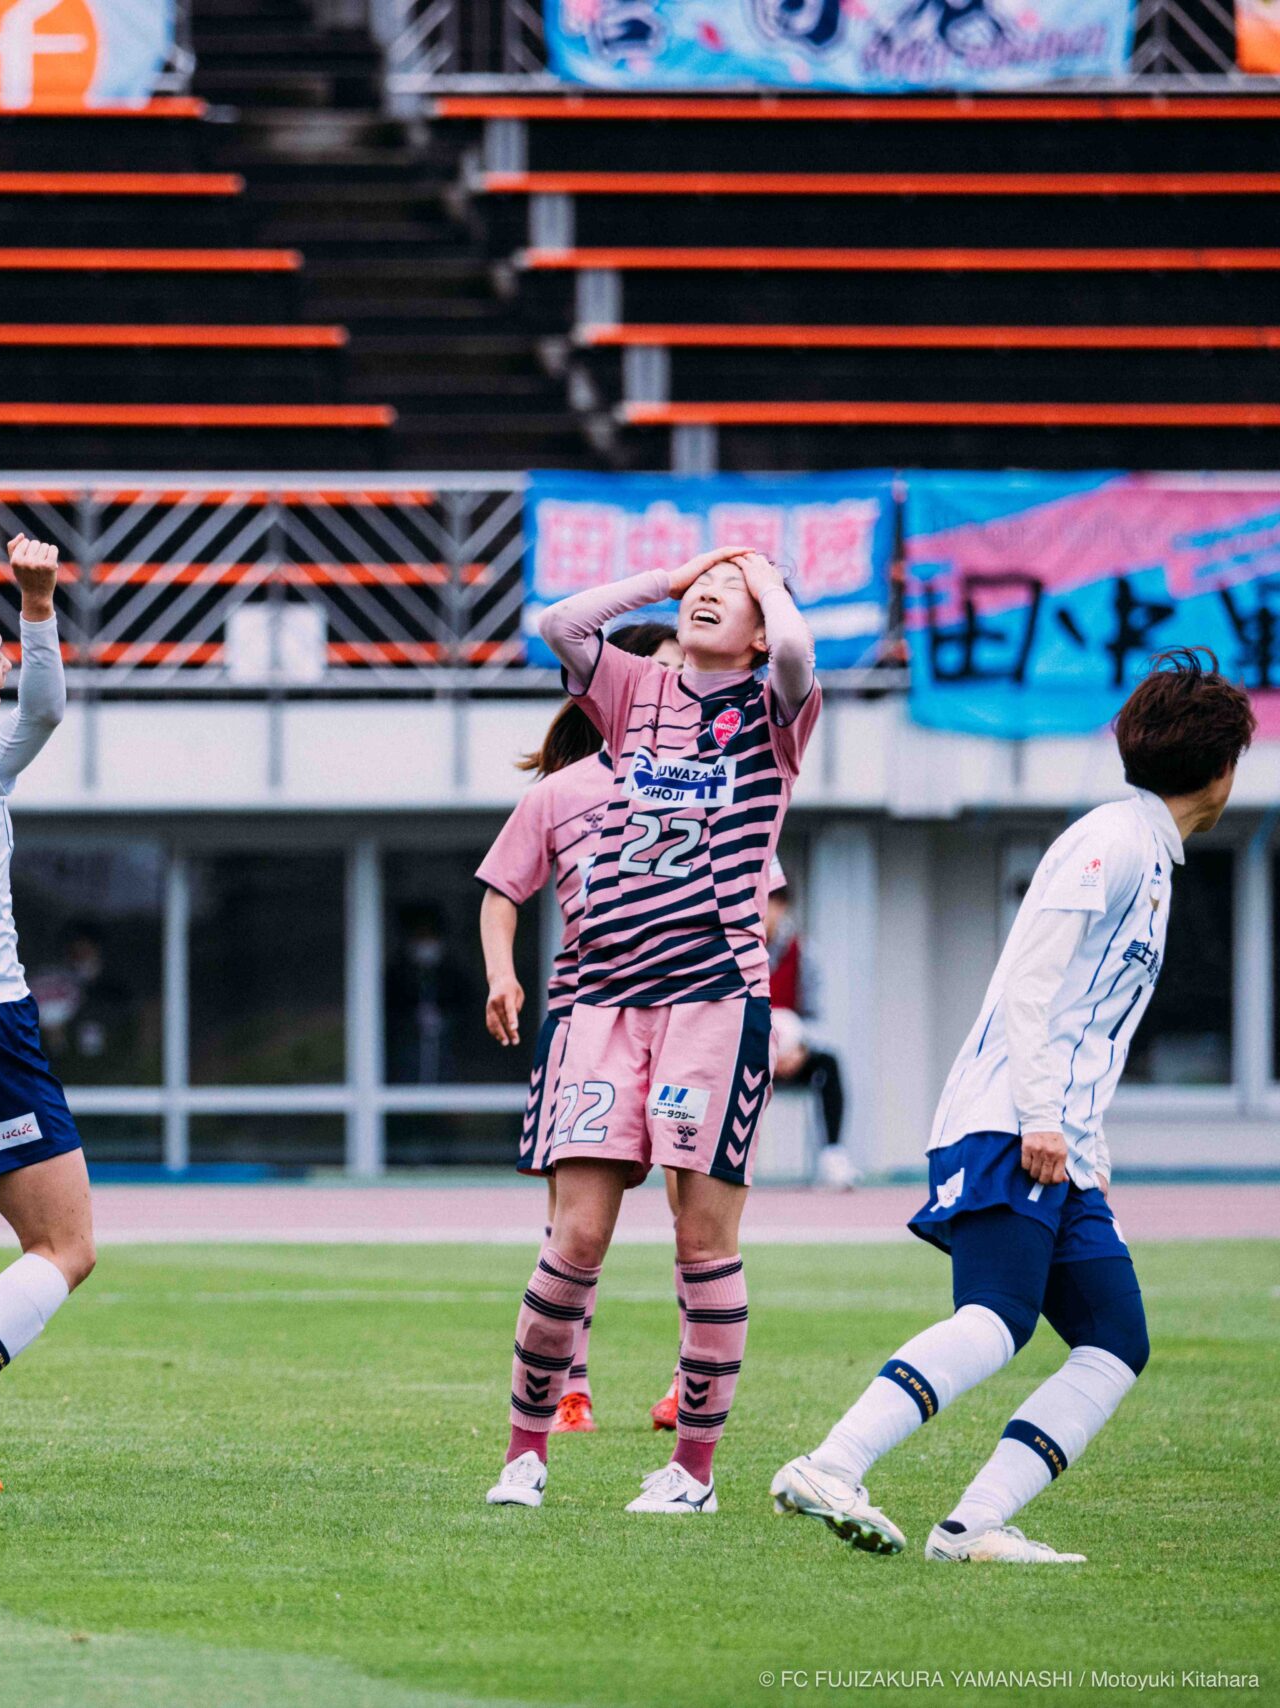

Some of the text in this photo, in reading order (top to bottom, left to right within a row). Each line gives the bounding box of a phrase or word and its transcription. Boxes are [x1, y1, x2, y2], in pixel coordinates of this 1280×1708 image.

[642, 786, 685, 802] SHOJI
[619, 813, 702, 878] 22
[553, 1081, 615, 1149] 22
[895, 1366, 910, 1380] FC
[1034, 1435, 1049, 1450] FC
